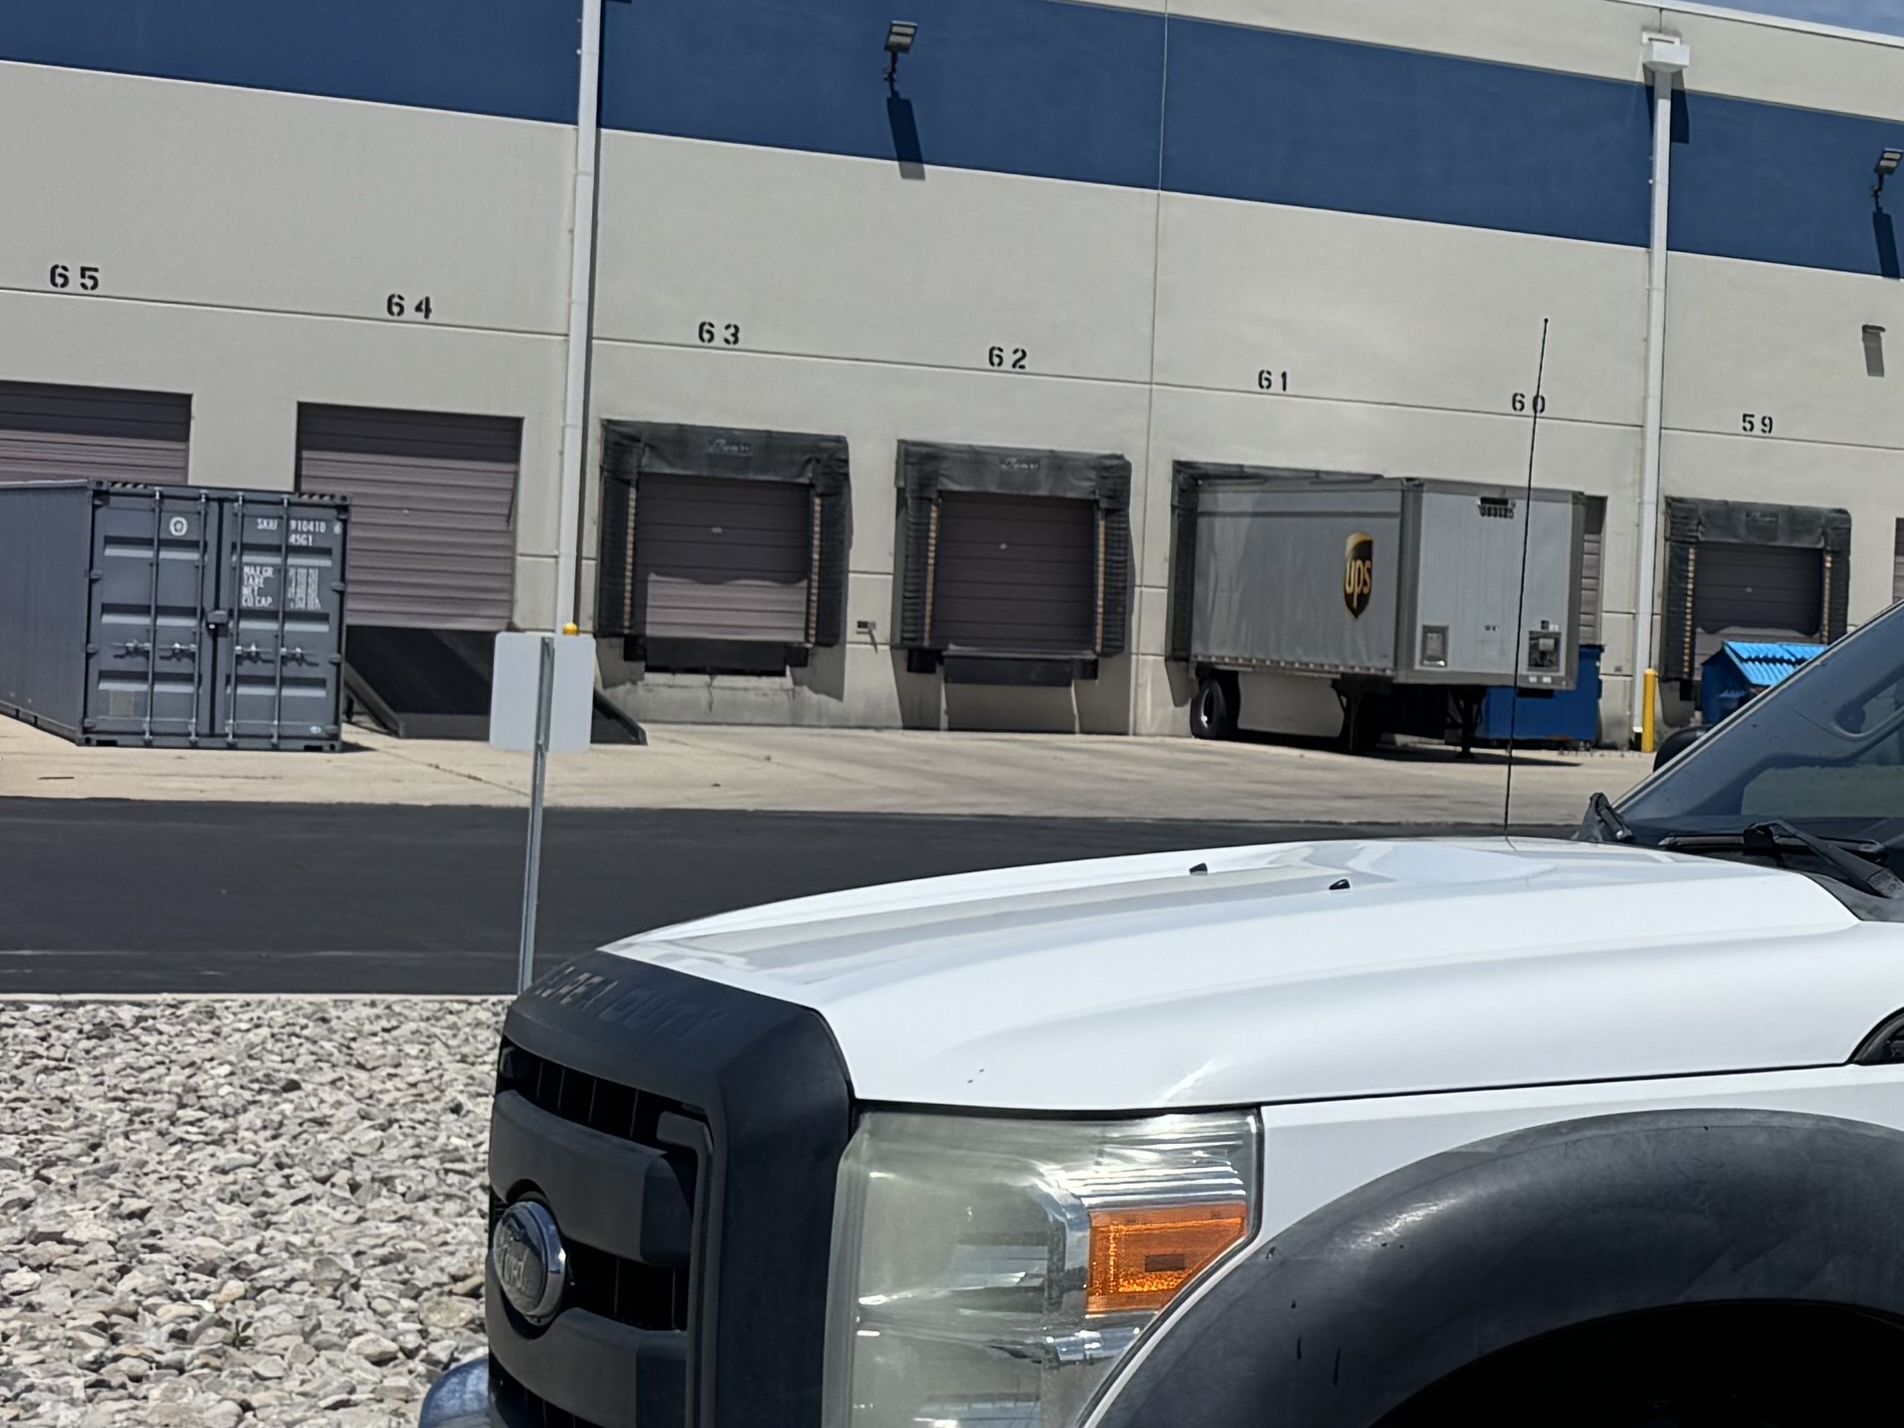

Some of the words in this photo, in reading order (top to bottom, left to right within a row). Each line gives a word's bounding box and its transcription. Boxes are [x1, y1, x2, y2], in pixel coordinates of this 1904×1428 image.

[49, 263, 100, 291] 65
[386, 293, 432, 320] 64
[698, 321, 740, 346] 63
[988, 346, 1028, 370] 62
[1258, 369, 1288, 392] 61
[1511, 392, 1546, 414] 60
[1742, 413, 1774, 434] 59
[1345, 558, 1371, 608] ups
